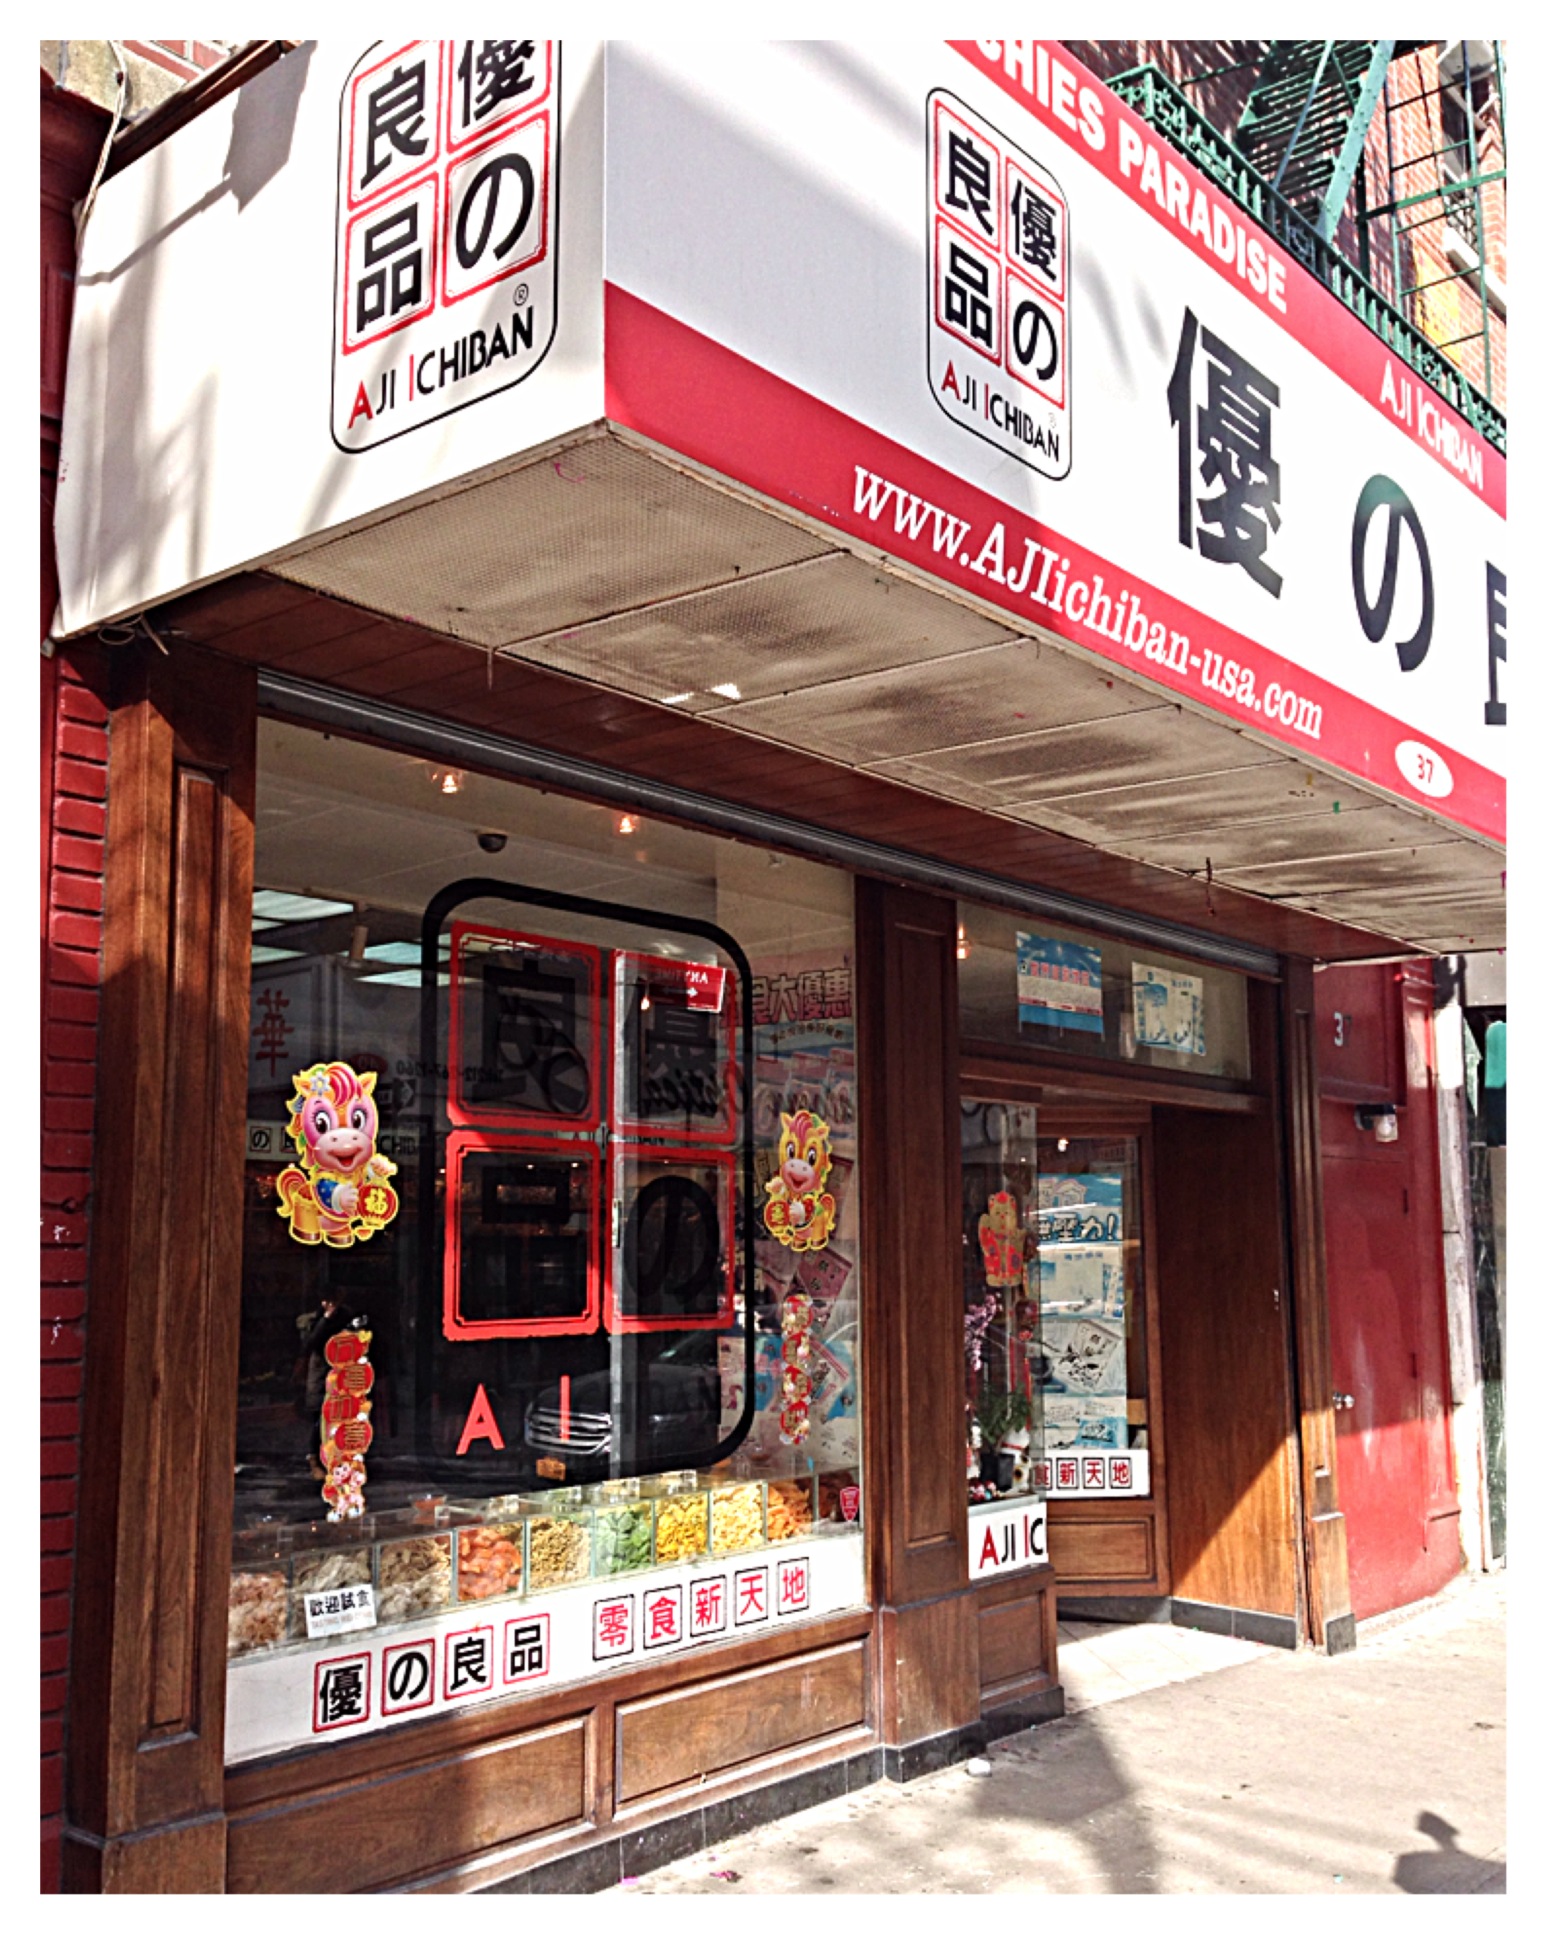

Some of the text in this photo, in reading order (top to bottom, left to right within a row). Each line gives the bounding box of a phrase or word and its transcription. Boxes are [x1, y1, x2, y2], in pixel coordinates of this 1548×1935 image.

[1118, 118, 1287, 315] PARADISE
[347, 306, 534, 429] AJI ICHIBAN
[941, 361, 1060, 462] AJI ICHIBAN
[1380, 359, 1484, 491] AJI ICHIBAN
[853, 464, 1324, 740] www.AJIichiban-usa.com
[1417, 754, 1434, 784] 37
[979, 1514, 1044, 1569] AJI IC
[319, 1566, 806, 1724] 優の良品 零食新天地
